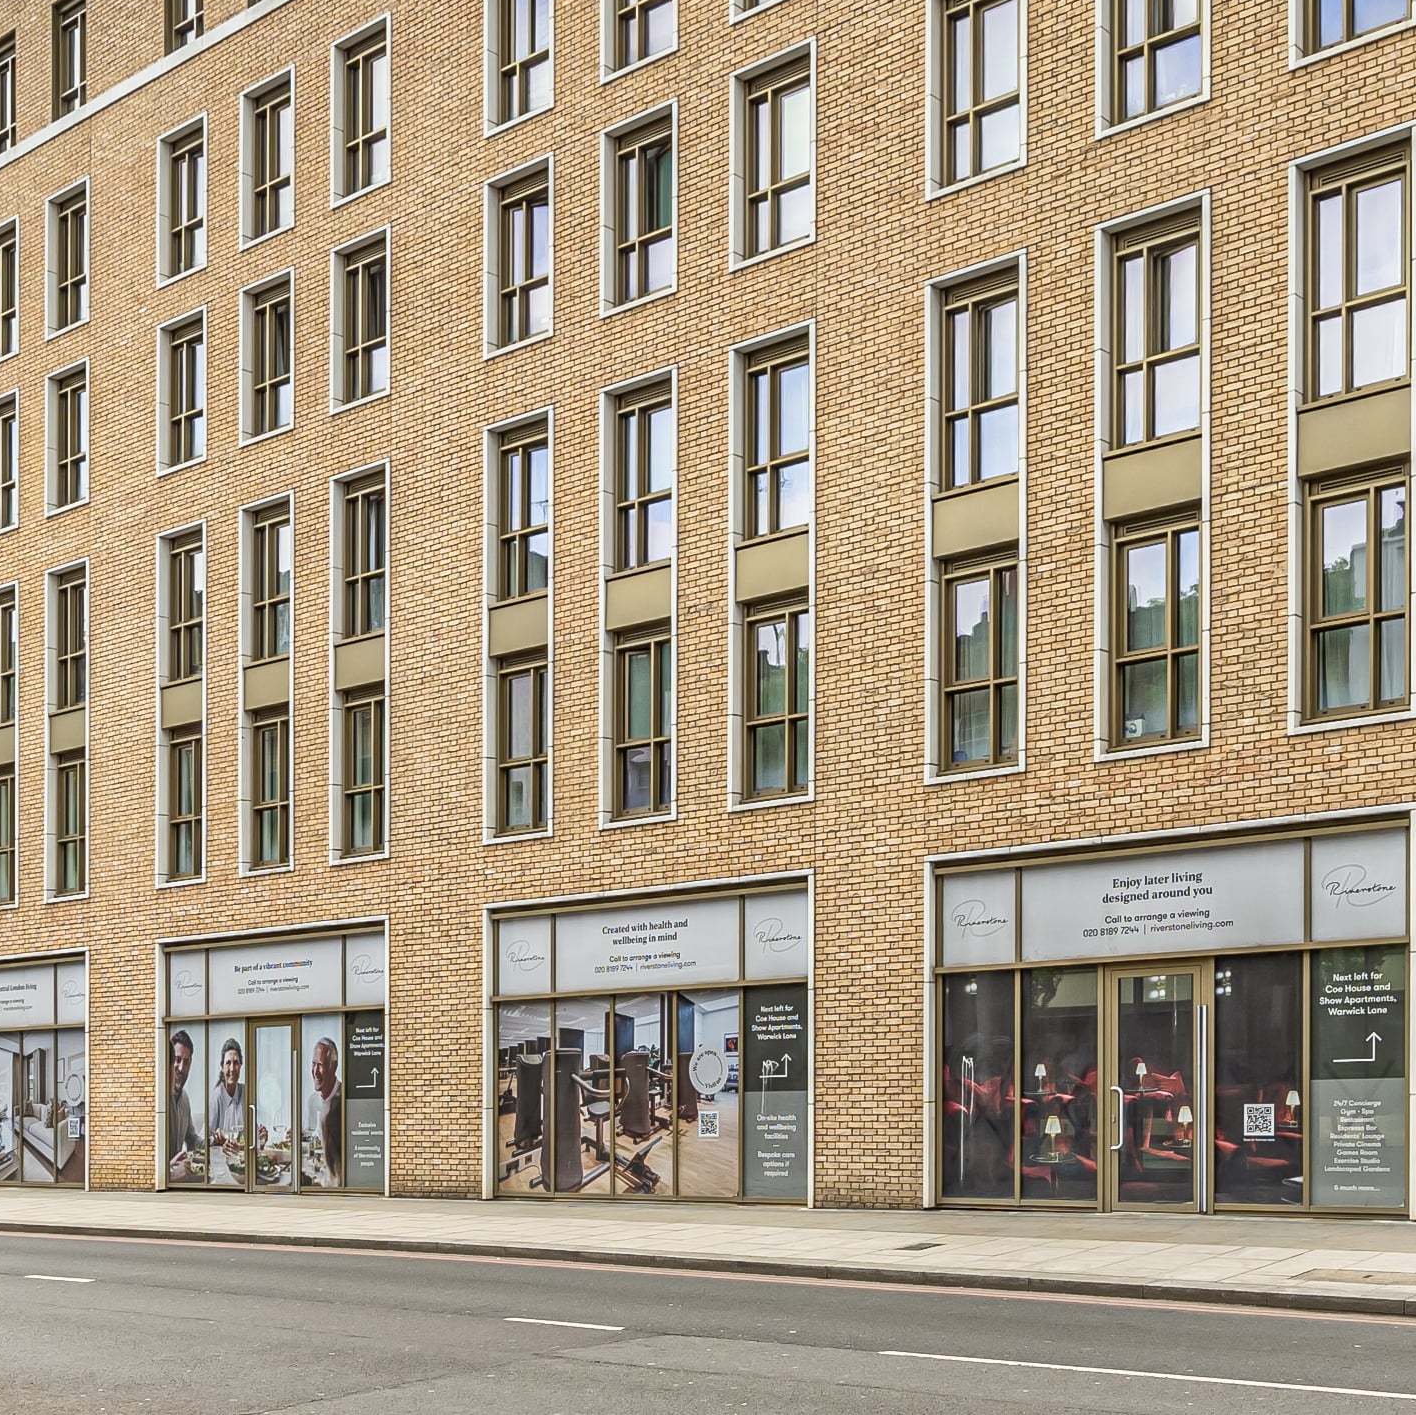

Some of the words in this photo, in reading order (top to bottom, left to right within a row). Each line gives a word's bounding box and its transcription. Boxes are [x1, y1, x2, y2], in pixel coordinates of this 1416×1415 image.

[1113, 877, 1142, 889] Enjoy
[1144, 875, 1169, 886] later
[1172, 872, 1203, 883] living
[1102, 890, 1149, 904] designed
[1151, 886, 1190, 899] around
[1193, 886, 1213, 899] you
[1105, 915, 1122, 924] Call
[1124, 914, 1132, 922] to
[1135, 913, 1167, 922] arrange
[1178, 909, 1210, 918] viewing
[602, 924, 629, 934] Created
[631, 923, 647, 932] with
[649, 920, 672, 931] health
[674, 919, 688, 928] and
[1083, 929, 1098, 937] 020
[1100, 927, 1118, 936] 8189
[1121, 926, 1139, 934] 7244
[1151, 920, 1234, 933] riverstoneliving.com
[613, 935, 647, 945] wellbeing
[649, 934, 656, 942] in
[658, 932, 677, 941] mind
[659, 951, 680, 959] viewing
[1354, 972, 1368, 980] left
[1371, 972, 1383, 980] for
[1325, 985, 1343, 993] Coe
[1345, 984, 1371, 992] House
[1374, 982, 1390, 991] and
[1319, 997, 1342, 1005] Show
[1344, 995, 1397, 1005] Apartments,
[1328, 1007, 1365, 1015] Warwick
[1367, 1006, 1387, 1014] Lane
